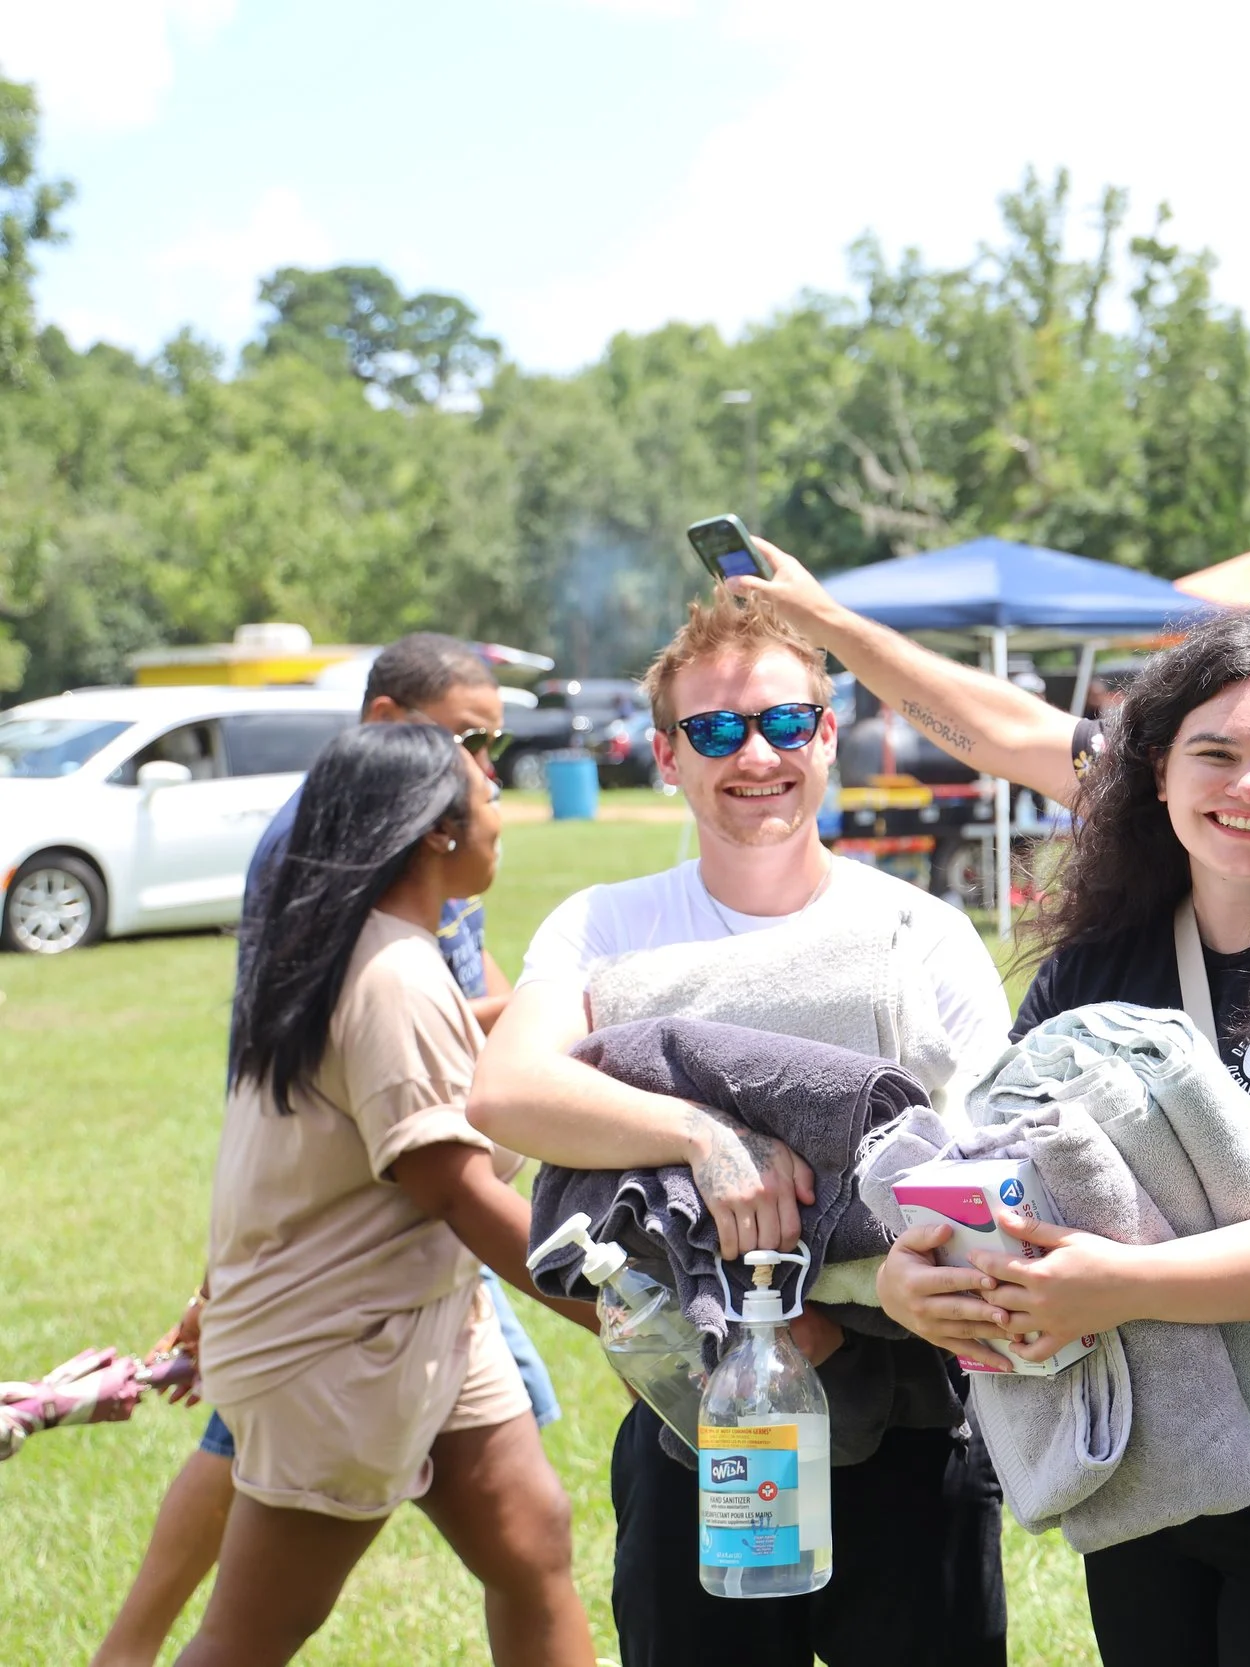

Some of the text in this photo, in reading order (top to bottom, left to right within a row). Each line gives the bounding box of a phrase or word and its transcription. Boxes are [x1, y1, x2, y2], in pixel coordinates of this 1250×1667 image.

[901, 698, 976, 752] TEMPORARY
[712, 1460, 746, 1480] Wish
[723, 1496, 751, 1504] SANITIZER
